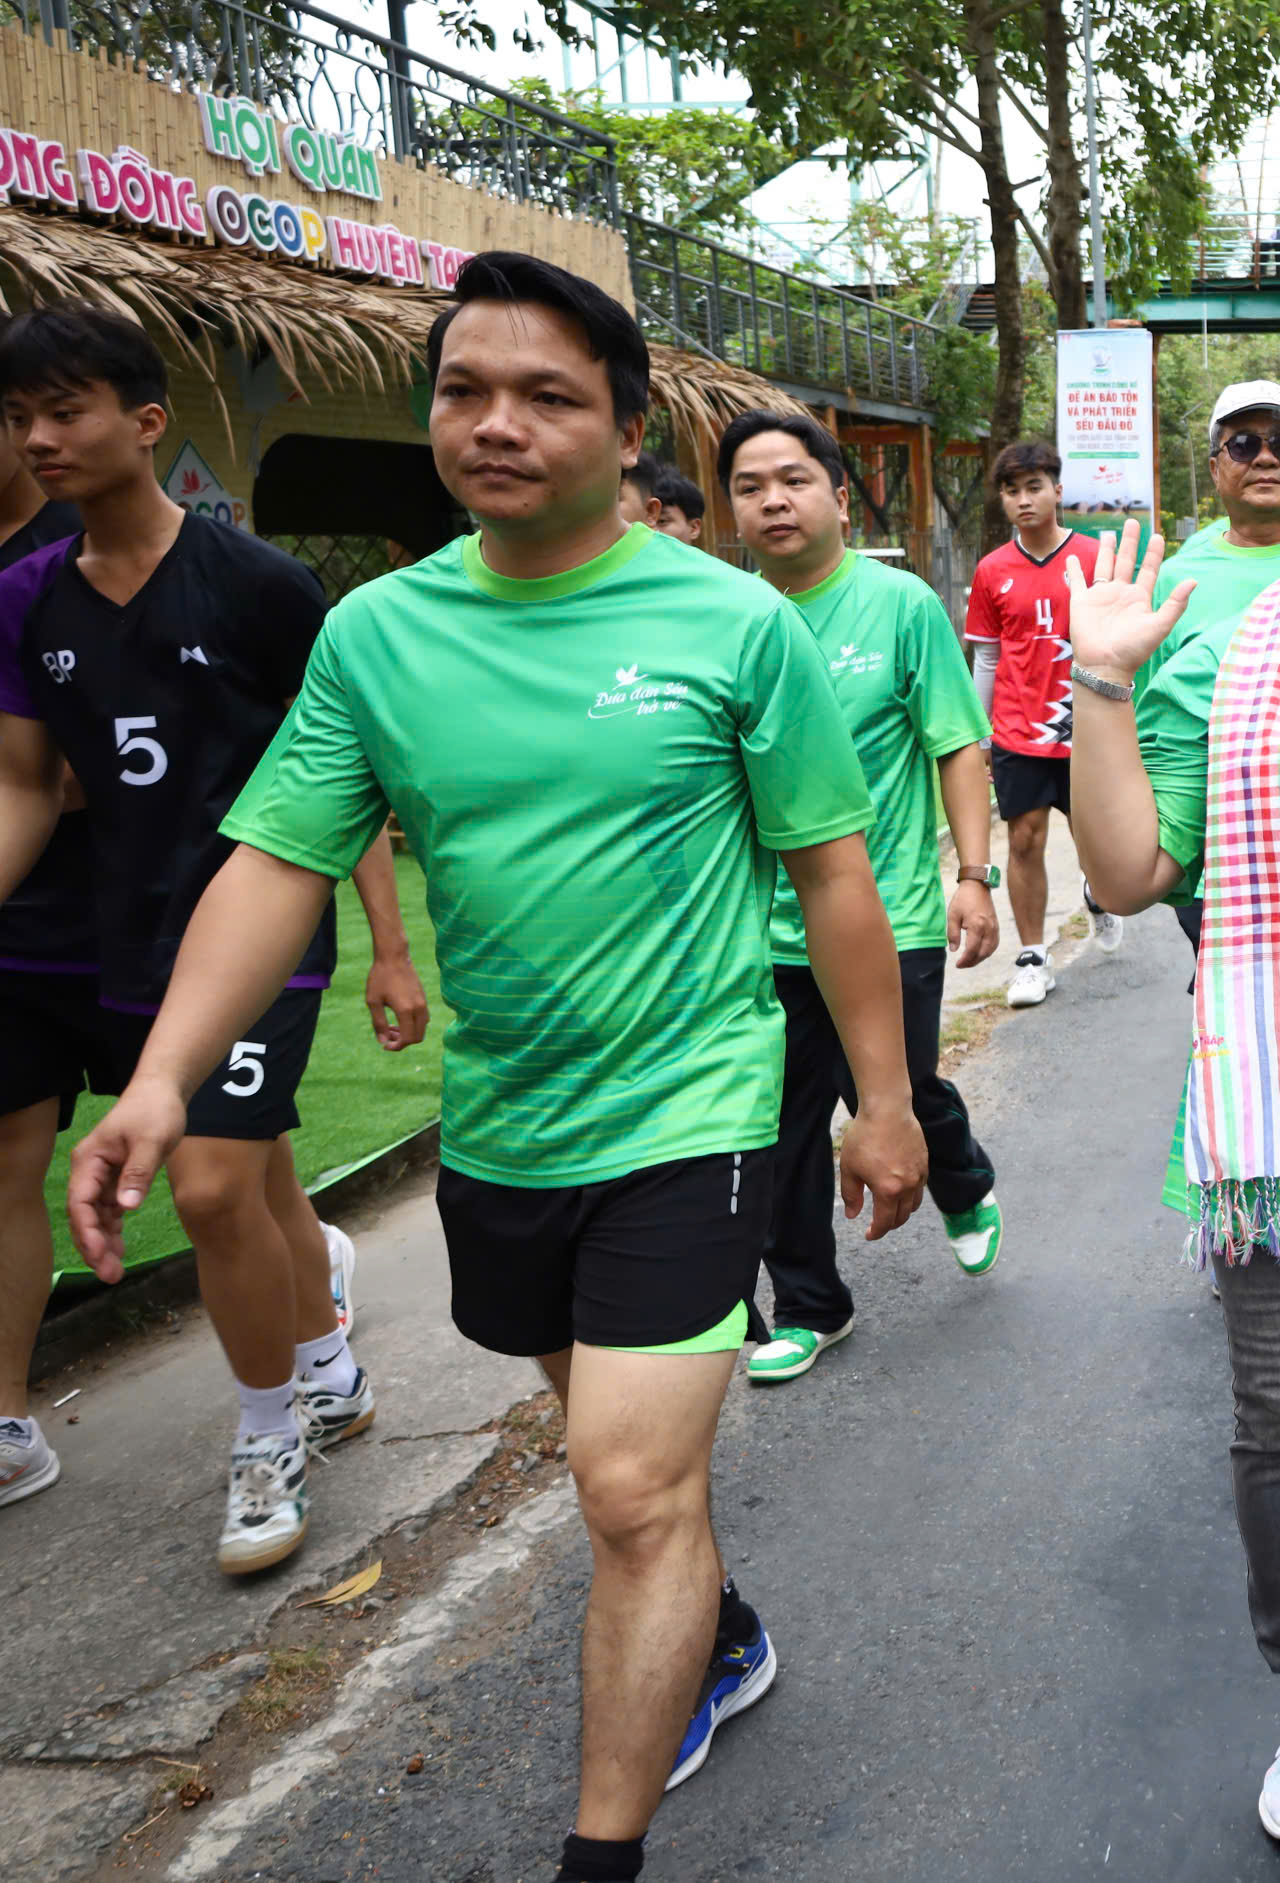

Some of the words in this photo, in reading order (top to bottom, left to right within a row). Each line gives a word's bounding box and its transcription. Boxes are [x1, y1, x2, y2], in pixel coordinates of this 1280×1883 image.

[200, 94, 281, 175] HỘI
[285, 125, 383, 201] QUÁN
[80, 146, 207, 237] ĐỒNG
[209, 185, 327, 261] OCOP
[328, 216, 424, 286] HUYỆN
[1036, 598, 1053, 633] 4
[115, 715, 169, 786] 5
[221, 1041, 267, 1097] 5
